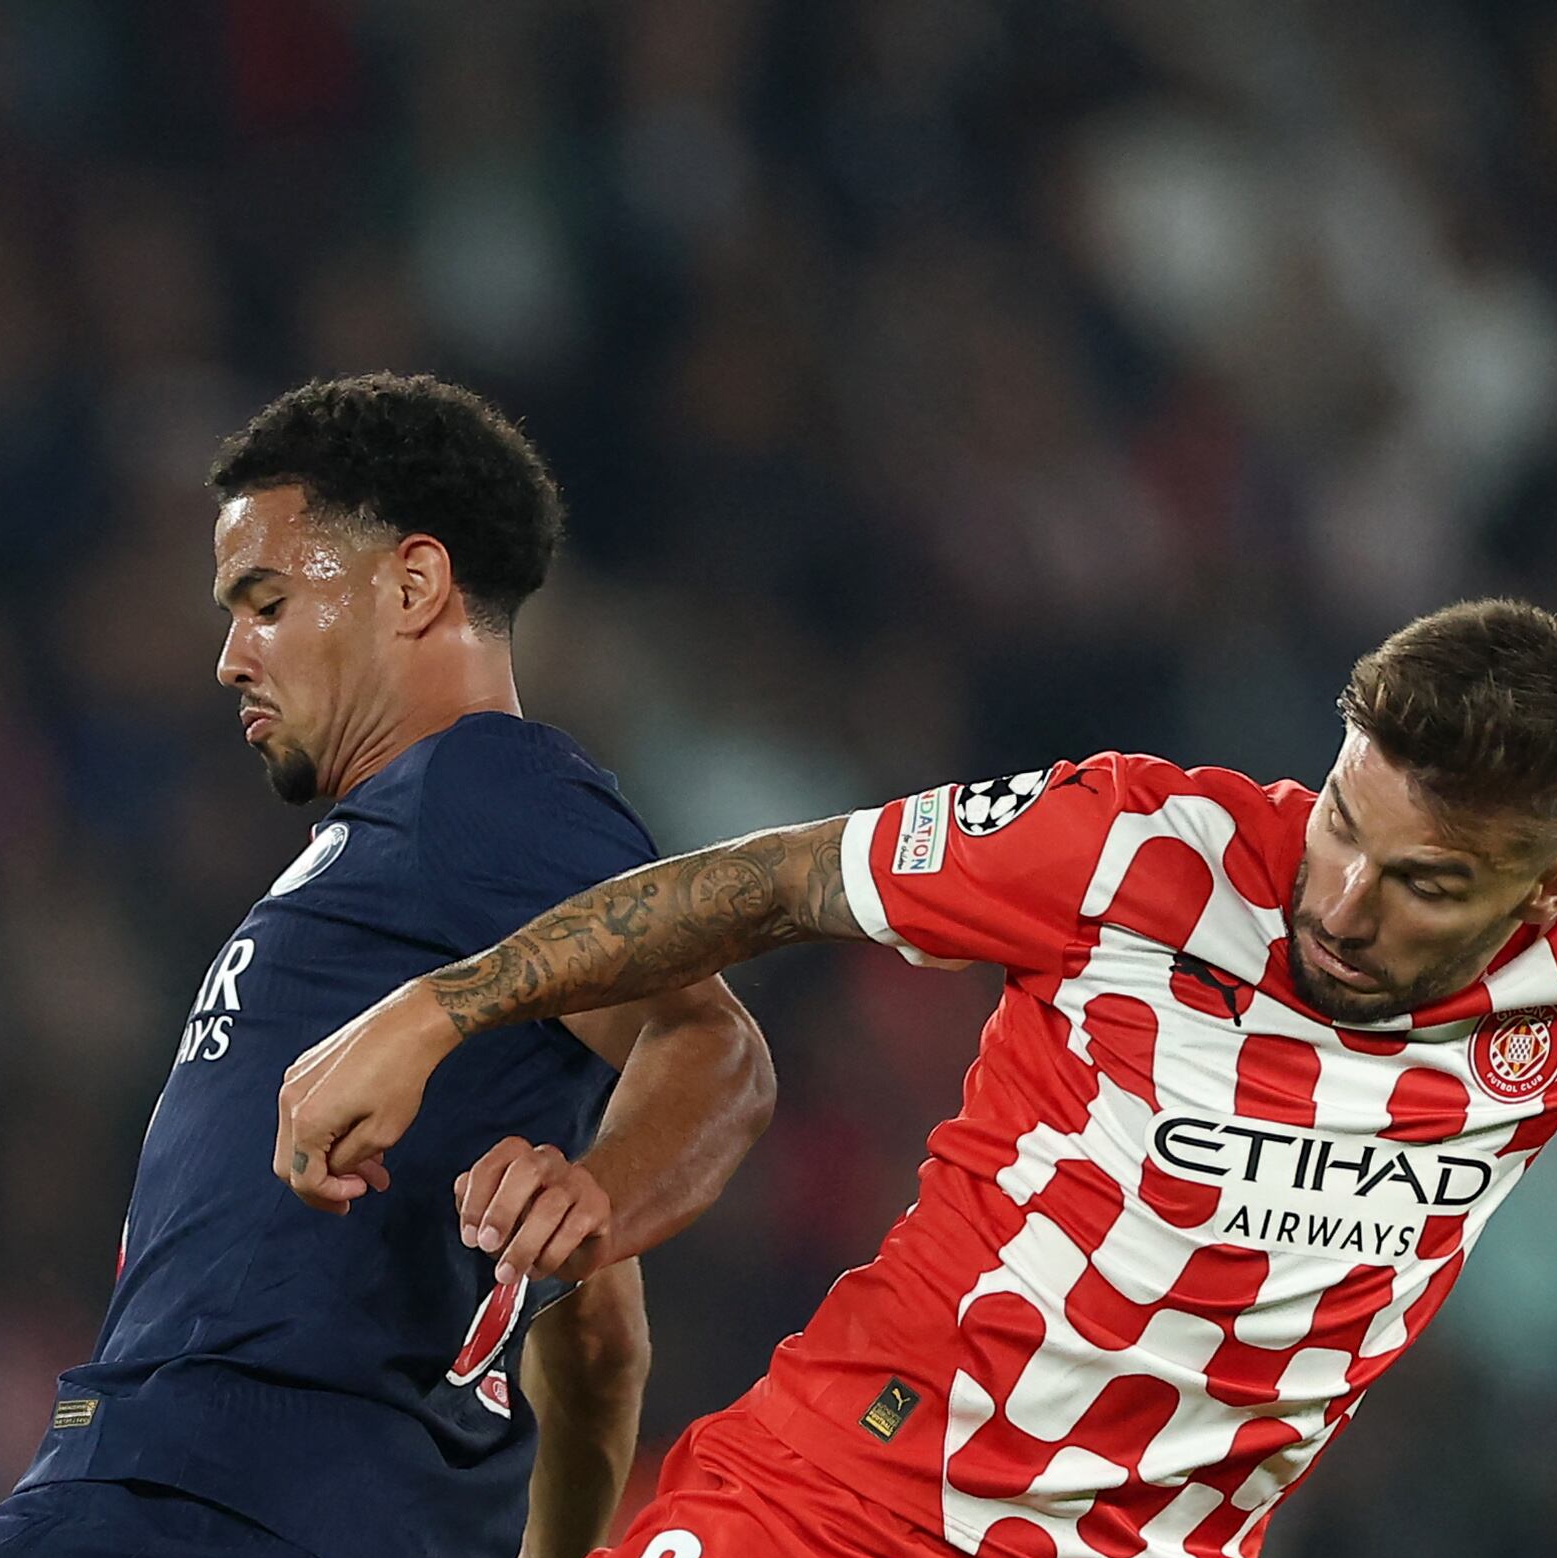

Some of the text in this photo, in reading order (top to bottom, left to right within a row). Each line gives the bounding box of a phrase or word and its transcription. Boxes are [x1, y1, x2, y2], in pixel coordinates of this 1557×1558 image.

[1486, 1072, 1544, 1092] FUTBOL CLUB
[1153, 1116, 1493, 1206] ETIHAD
[1223, 1205, 1416, 1257] AIRWAYS
